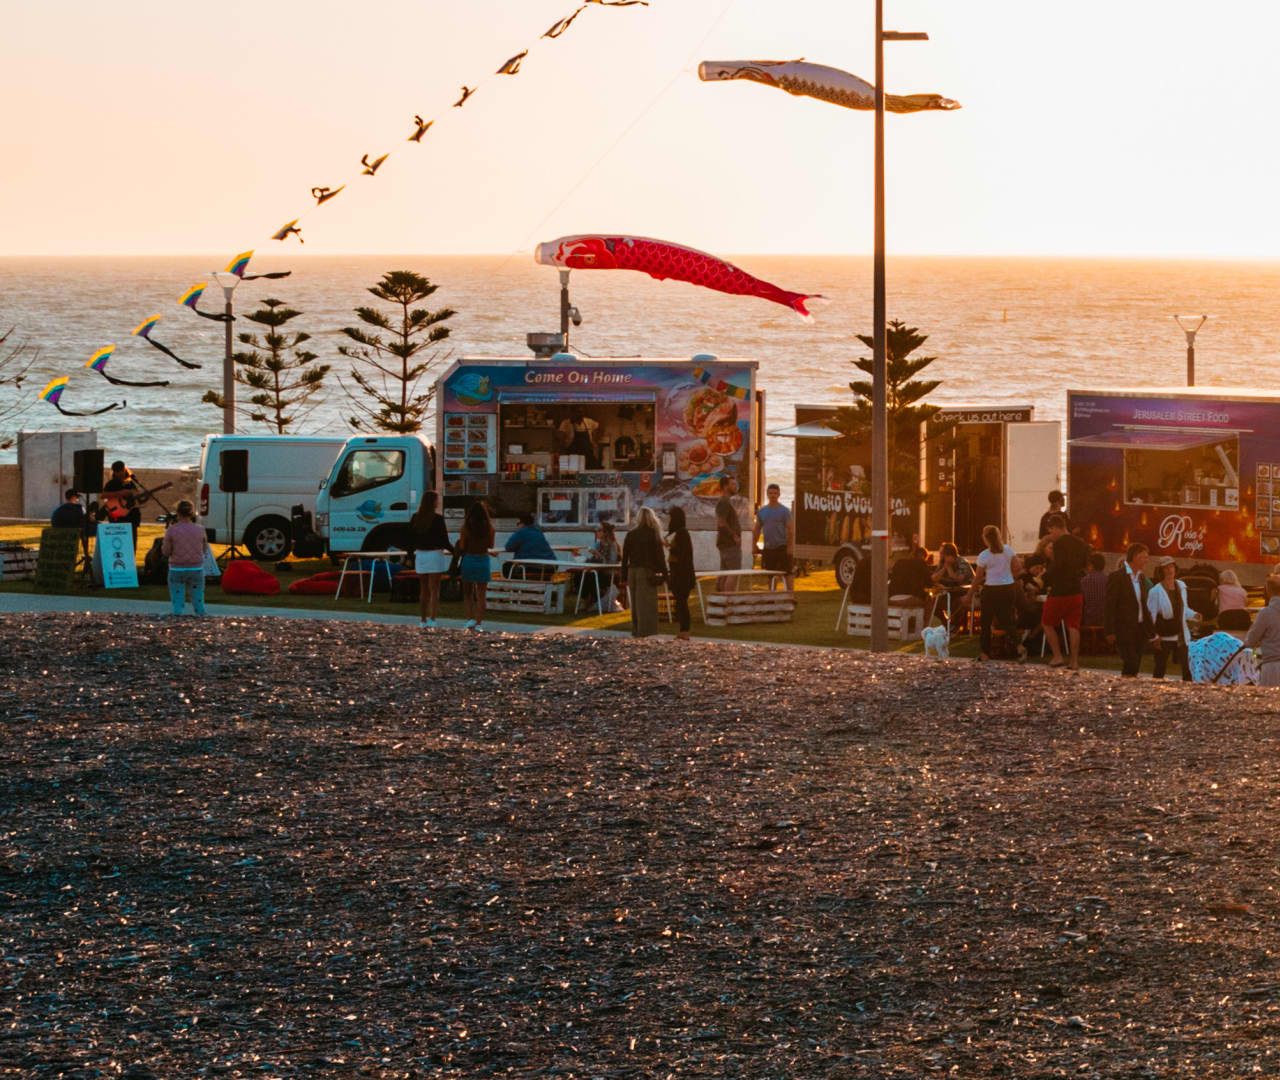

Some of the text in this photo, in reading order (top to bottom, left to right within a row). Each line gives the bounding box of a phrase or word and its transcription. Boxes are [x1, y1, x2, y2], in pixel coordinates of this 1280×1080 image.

[525, 370, 633, 384] Come On Home
[932, 411, 1022, 423] Check us out here
[1132, 408, 1230, 424] JERUSALEM STREET FOOD
[804, 492, 842, 512] NACHO
